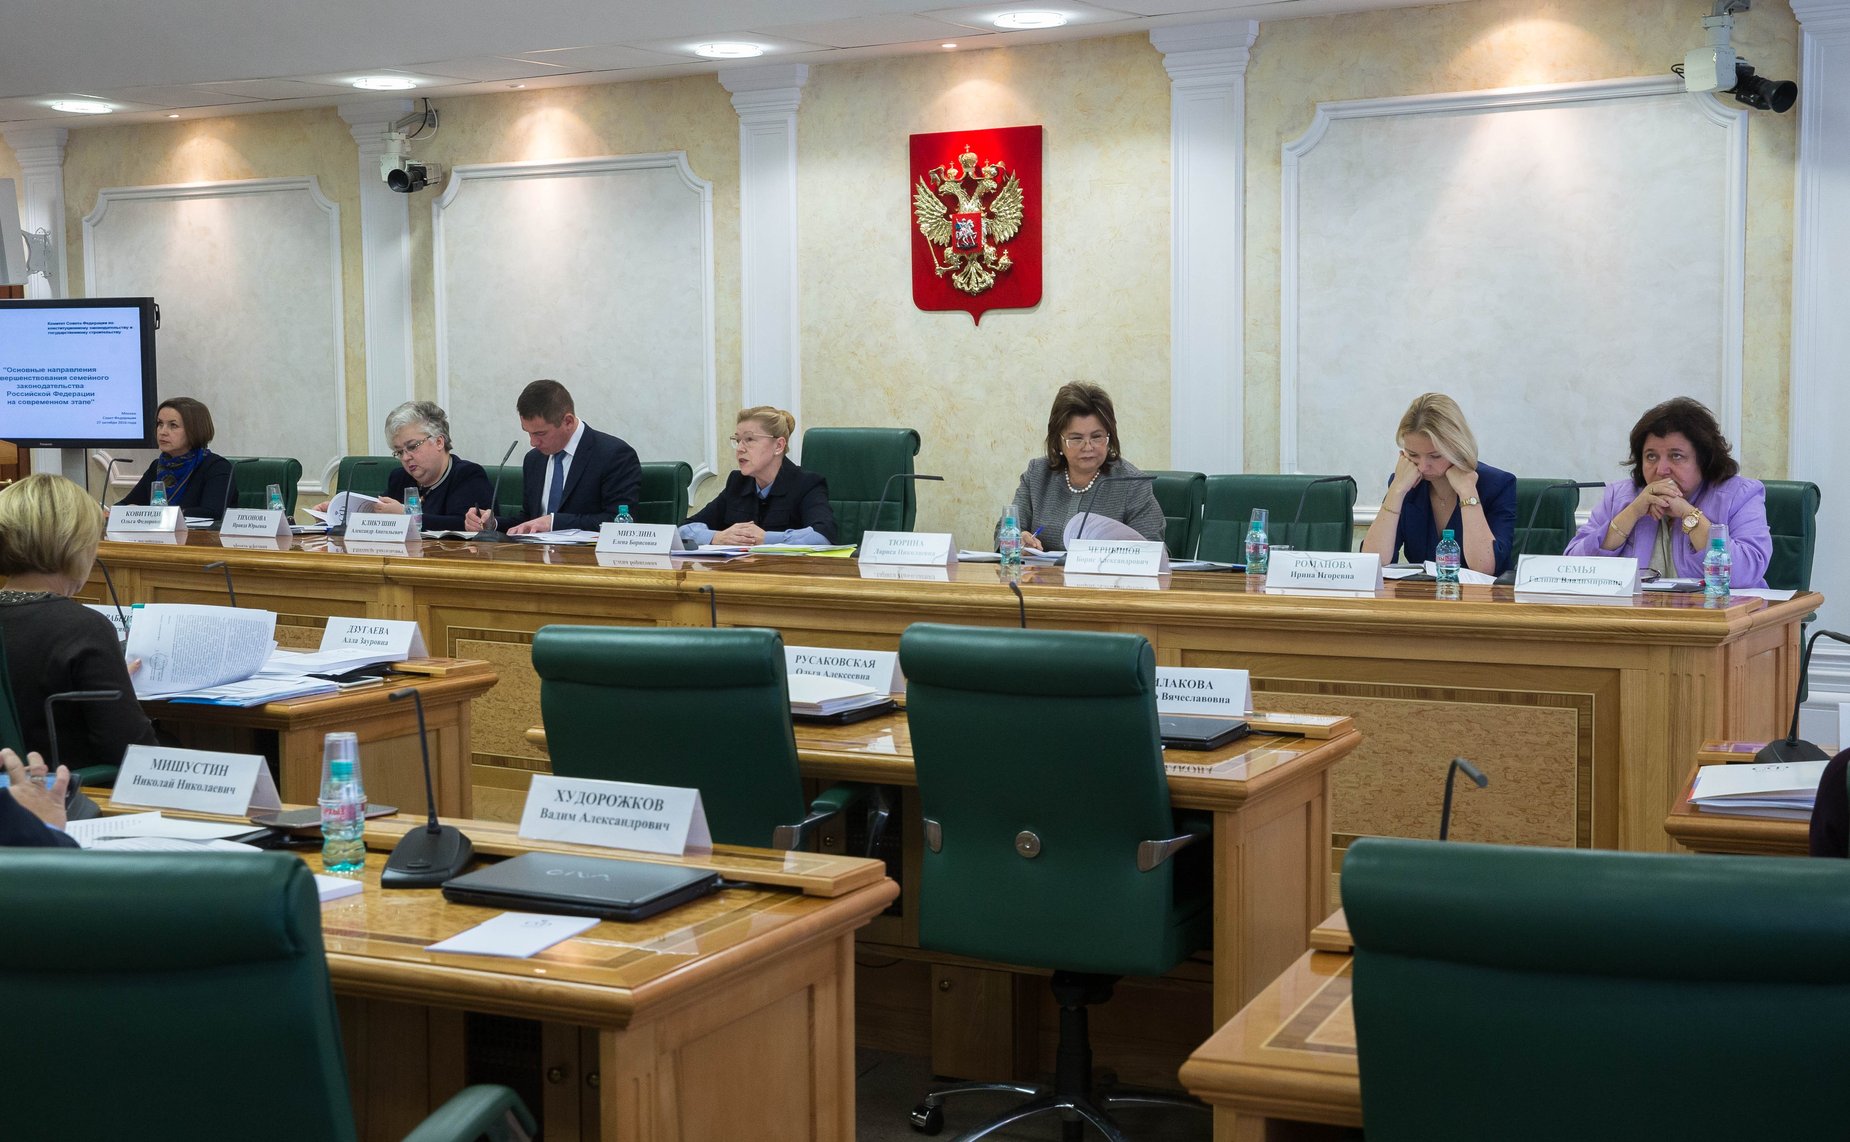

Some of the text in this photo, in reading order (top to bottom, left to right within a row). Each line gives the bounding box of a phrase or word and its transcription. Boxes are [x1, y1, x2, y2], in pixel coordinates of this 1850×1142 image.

[47, 366, 97, 374] направления
[616, 530, 657, 538] МИЗУЛИНА
[629, 539, 657, 547] Борисовна
[888, 538, 925, 547] ТЮРИНА
[873, 548, 936, 557] Лариса Николаевна
[1088, 545, 1141, 555] ЧЕРНЫШОВ
[1076, 555, 1149, 567] Борис Александрович
[1294, 559, 1353, 569] РОМАНОВА
[1557, 564, 1597, 574] СЕМЬЯ
[1290, 570, 1355, 581] Ирина Игоревна
[1528, 575, 1623, 587] Галина Владимировна
[346, 625, 389, 635] ДЗУГАЕВА
[360, 637, 389, 646] Зауровна
[795, 654, 876, 669] РУСАКОВСКАЯ
[795, 667, 870, 681] Ольга Алексеевна
[1161, 692, 1231, 704] Вячеславовна
[150, 758, 230, 777] МИШУСТИН
[132, 774, 236, 795] Николай Николаевич
[554, 789, 665, 812] ХУДОРОЖКОВ
[539, 807, 670, 831] Вадим Александрович
